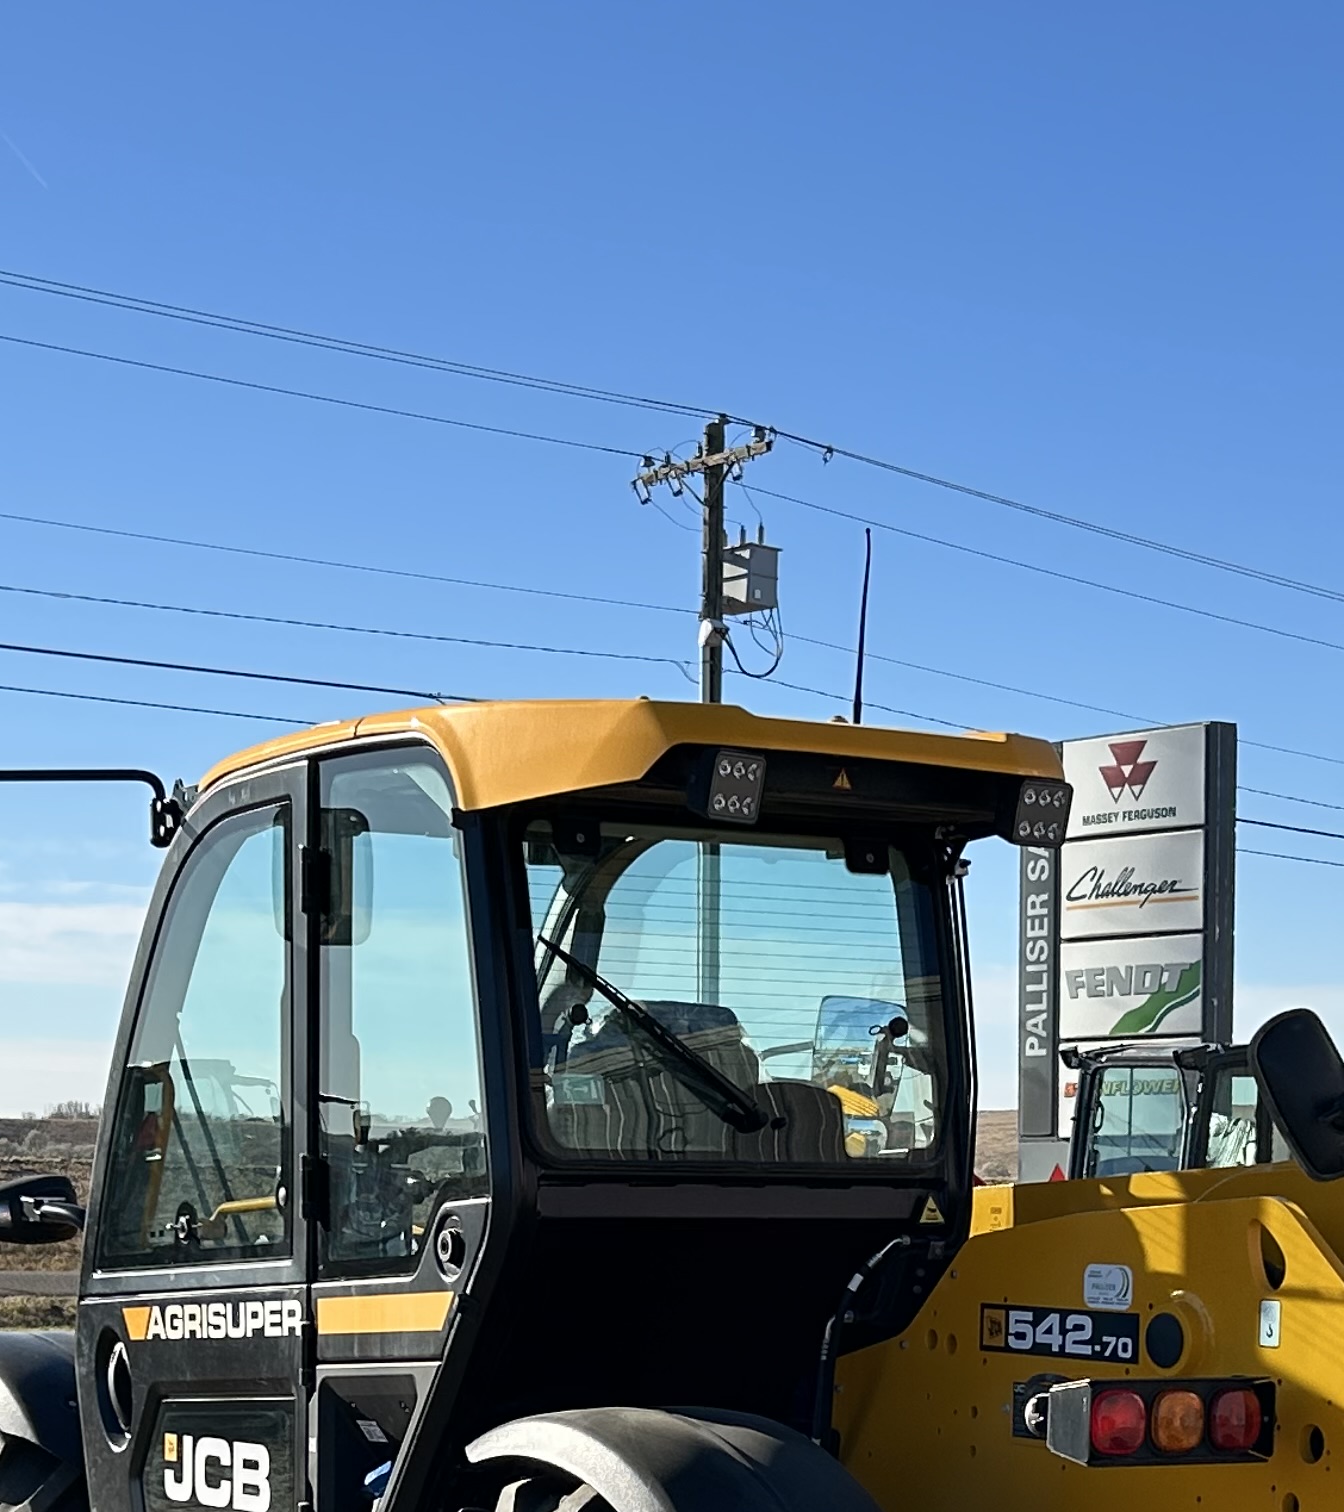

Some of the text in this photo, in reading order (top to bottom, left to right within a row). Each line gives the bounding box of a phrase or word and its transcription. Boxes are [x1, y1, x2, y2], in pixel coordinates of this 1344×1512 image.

[1082, 806, 1177, 827] MASSEY FERGUSON
[1065, 865, 1199, 909] Challenger
[1025, 893, 1050, 1057] PALLISER
[1065, 962, 1192, 999] FENDT
[146, 1299, 303, 1340] AGRISUPER
